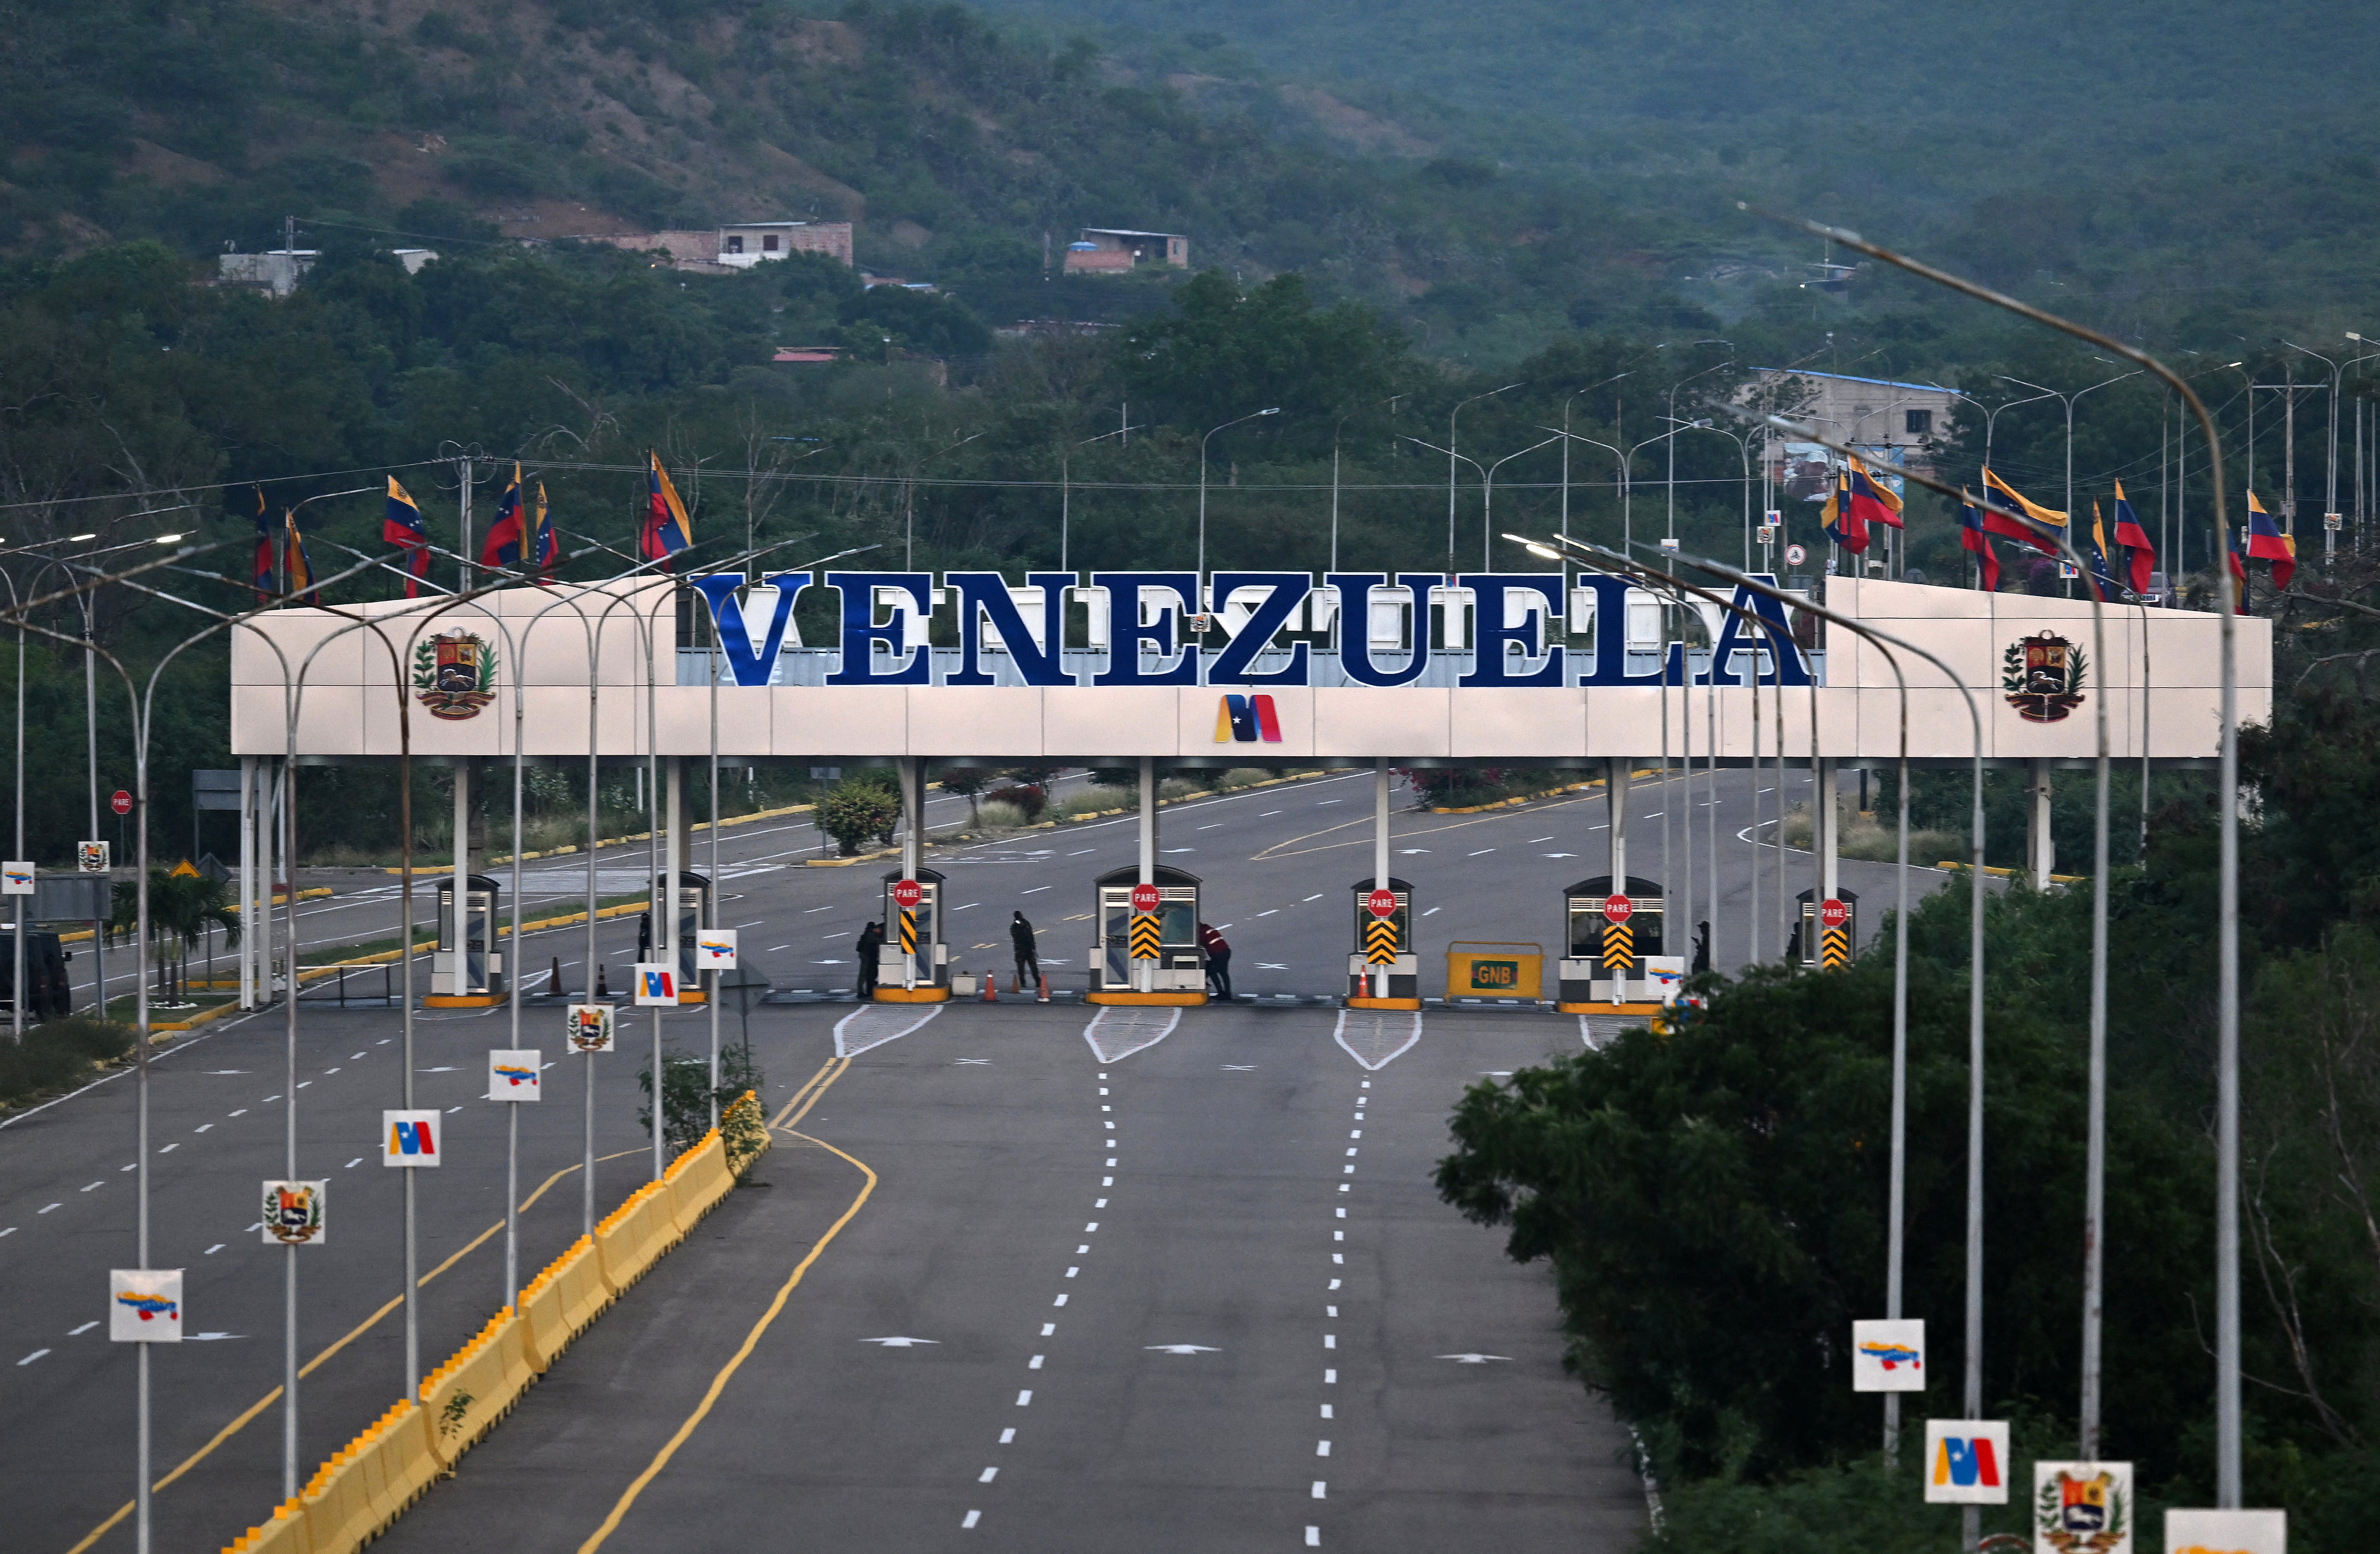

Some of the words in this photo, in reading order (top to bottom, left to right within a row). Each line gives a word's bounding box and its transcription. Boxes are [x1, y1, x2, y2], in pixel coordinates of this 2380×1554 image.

[686, 570, 1818, 687] VENEZUELA
[896, 889, 918, 897] PARE
[1135, 893, 1157, 902] PARE
[1370, 899, 1393, 907] PARE
[1606, 904, 1630, 913] PARE
[1821, 909, 1844, 918] PARE
[1479, 966, 1510, 984] GNB
